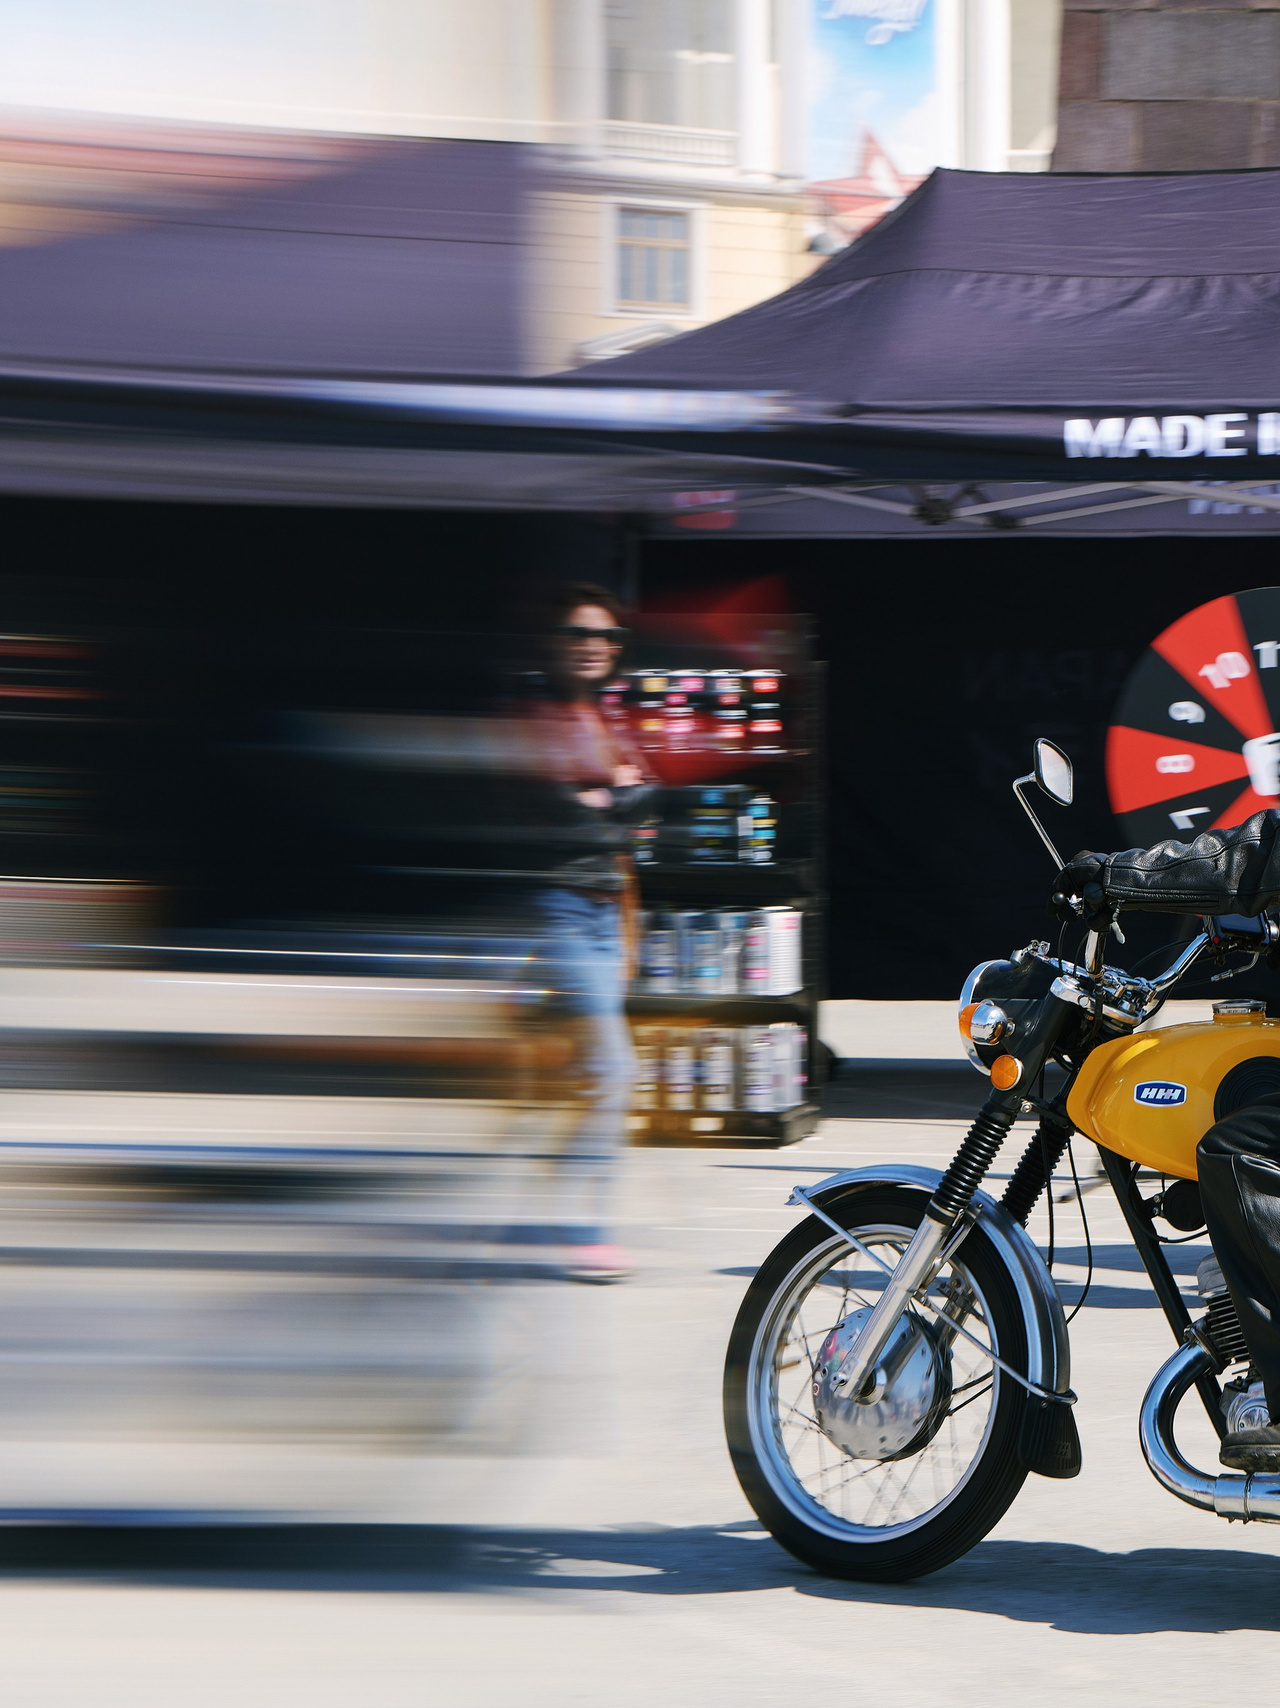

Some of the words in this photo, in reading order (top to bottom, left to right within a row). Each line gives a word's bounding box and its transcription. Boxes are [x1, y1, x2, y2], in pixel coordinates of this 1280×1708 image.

[1063, 413, 1248, 458] MADE
[1198, 651, 1251, 689] 10
[1168, 701, 1206, 724] 9
[1155, 754, 1196, 774] 8
[1168, 806, 1212, 830] 7
